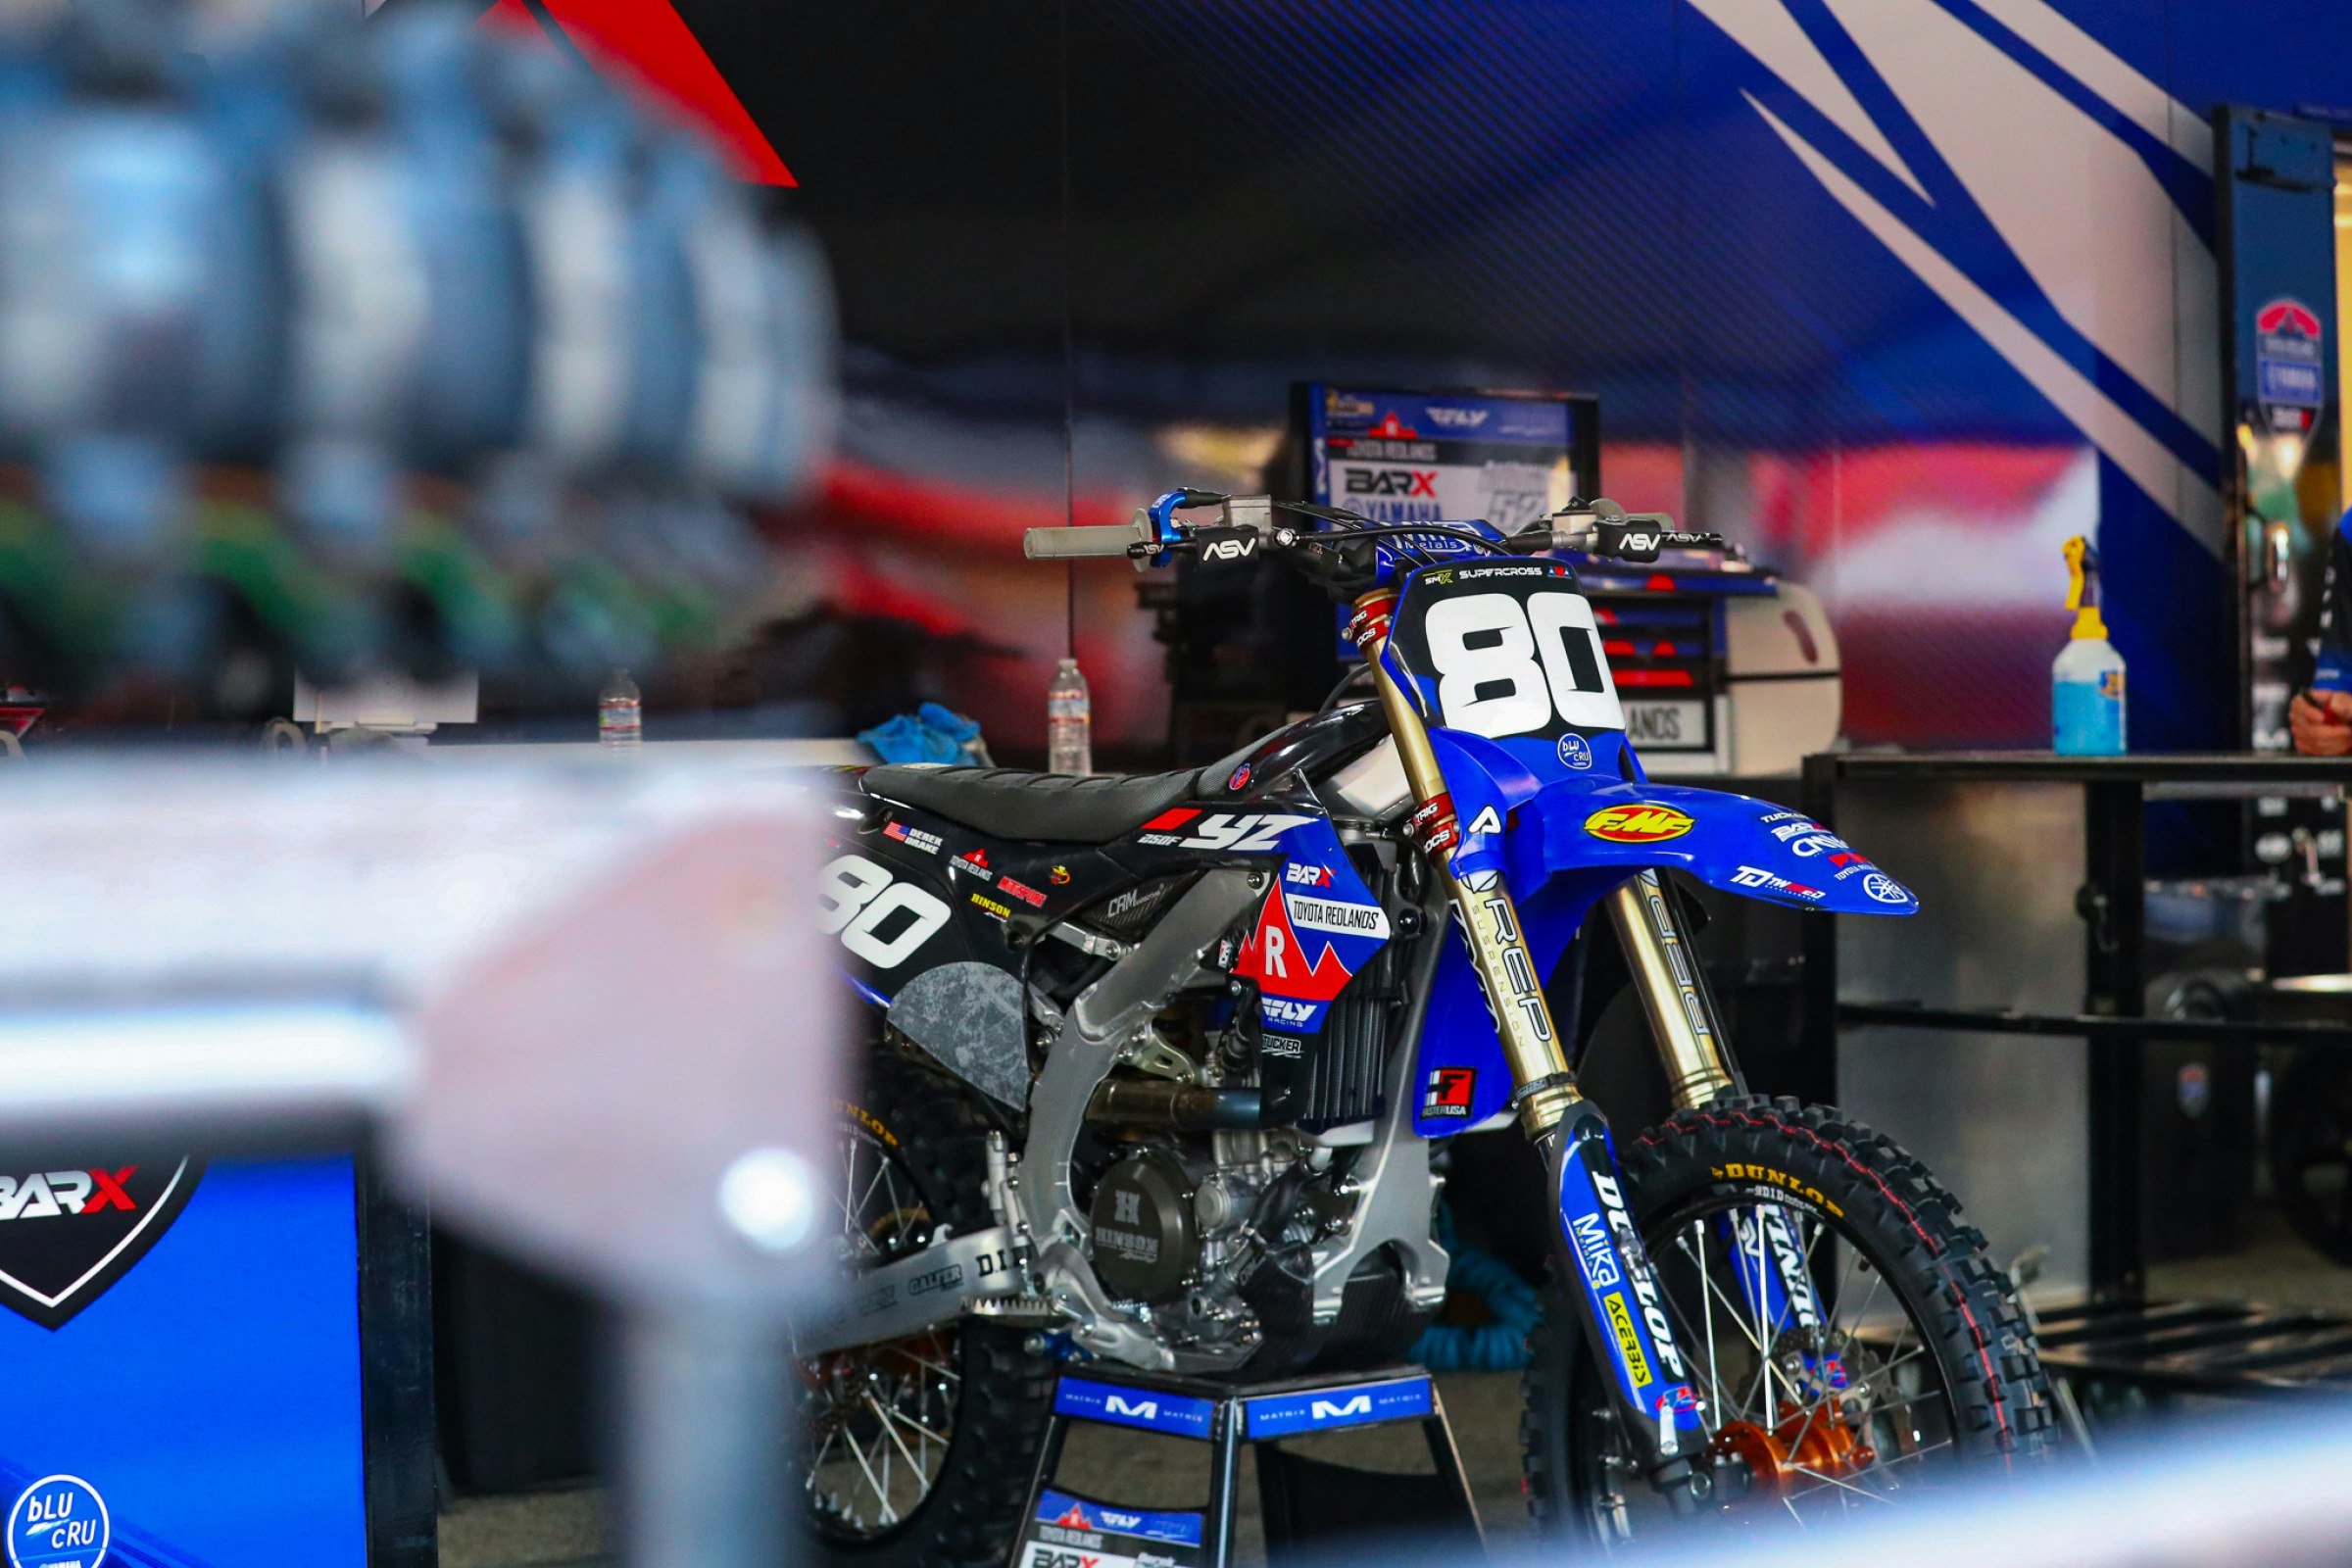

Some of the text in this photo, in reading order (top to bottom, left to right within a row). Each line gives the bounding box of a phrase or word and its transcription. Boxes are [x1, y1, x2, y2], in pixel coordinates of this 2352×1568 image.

[1345, 469, 1438, 498] BARX
[1202, 538, 1255, 562] ASV
[1619, 533, 1660, 551] ASV
[1458, 566, 1543, 580] SUPERCROSS
[1425, 592, 1627, 740] 80
[907, 827, 944, 847] DEREK
[1585, 810, 1694, 835] FMF
[904, 836, 940, 856] DRAKE
[1285, 862, 1338, 889] BARX
[817, 855, 952, 969] 80
[1293, 900, 1380, 930] TOYOTA REDLANDS
[1265, 924, 1288, 979] R
[1471, 905, 1525, 1048] SUSPENSION
[1485, 897, 1552, 1043] REP
[1267, 1016, 1303, 1028] RACING
[1262, 1035, 1301, 1054] TUCKER
[1725, 1162, 1844, 1218] DUNLOP
[1572, 1212, 1620, 1287] Mika
[1592, 1170, 1686, 1379] DULOP
